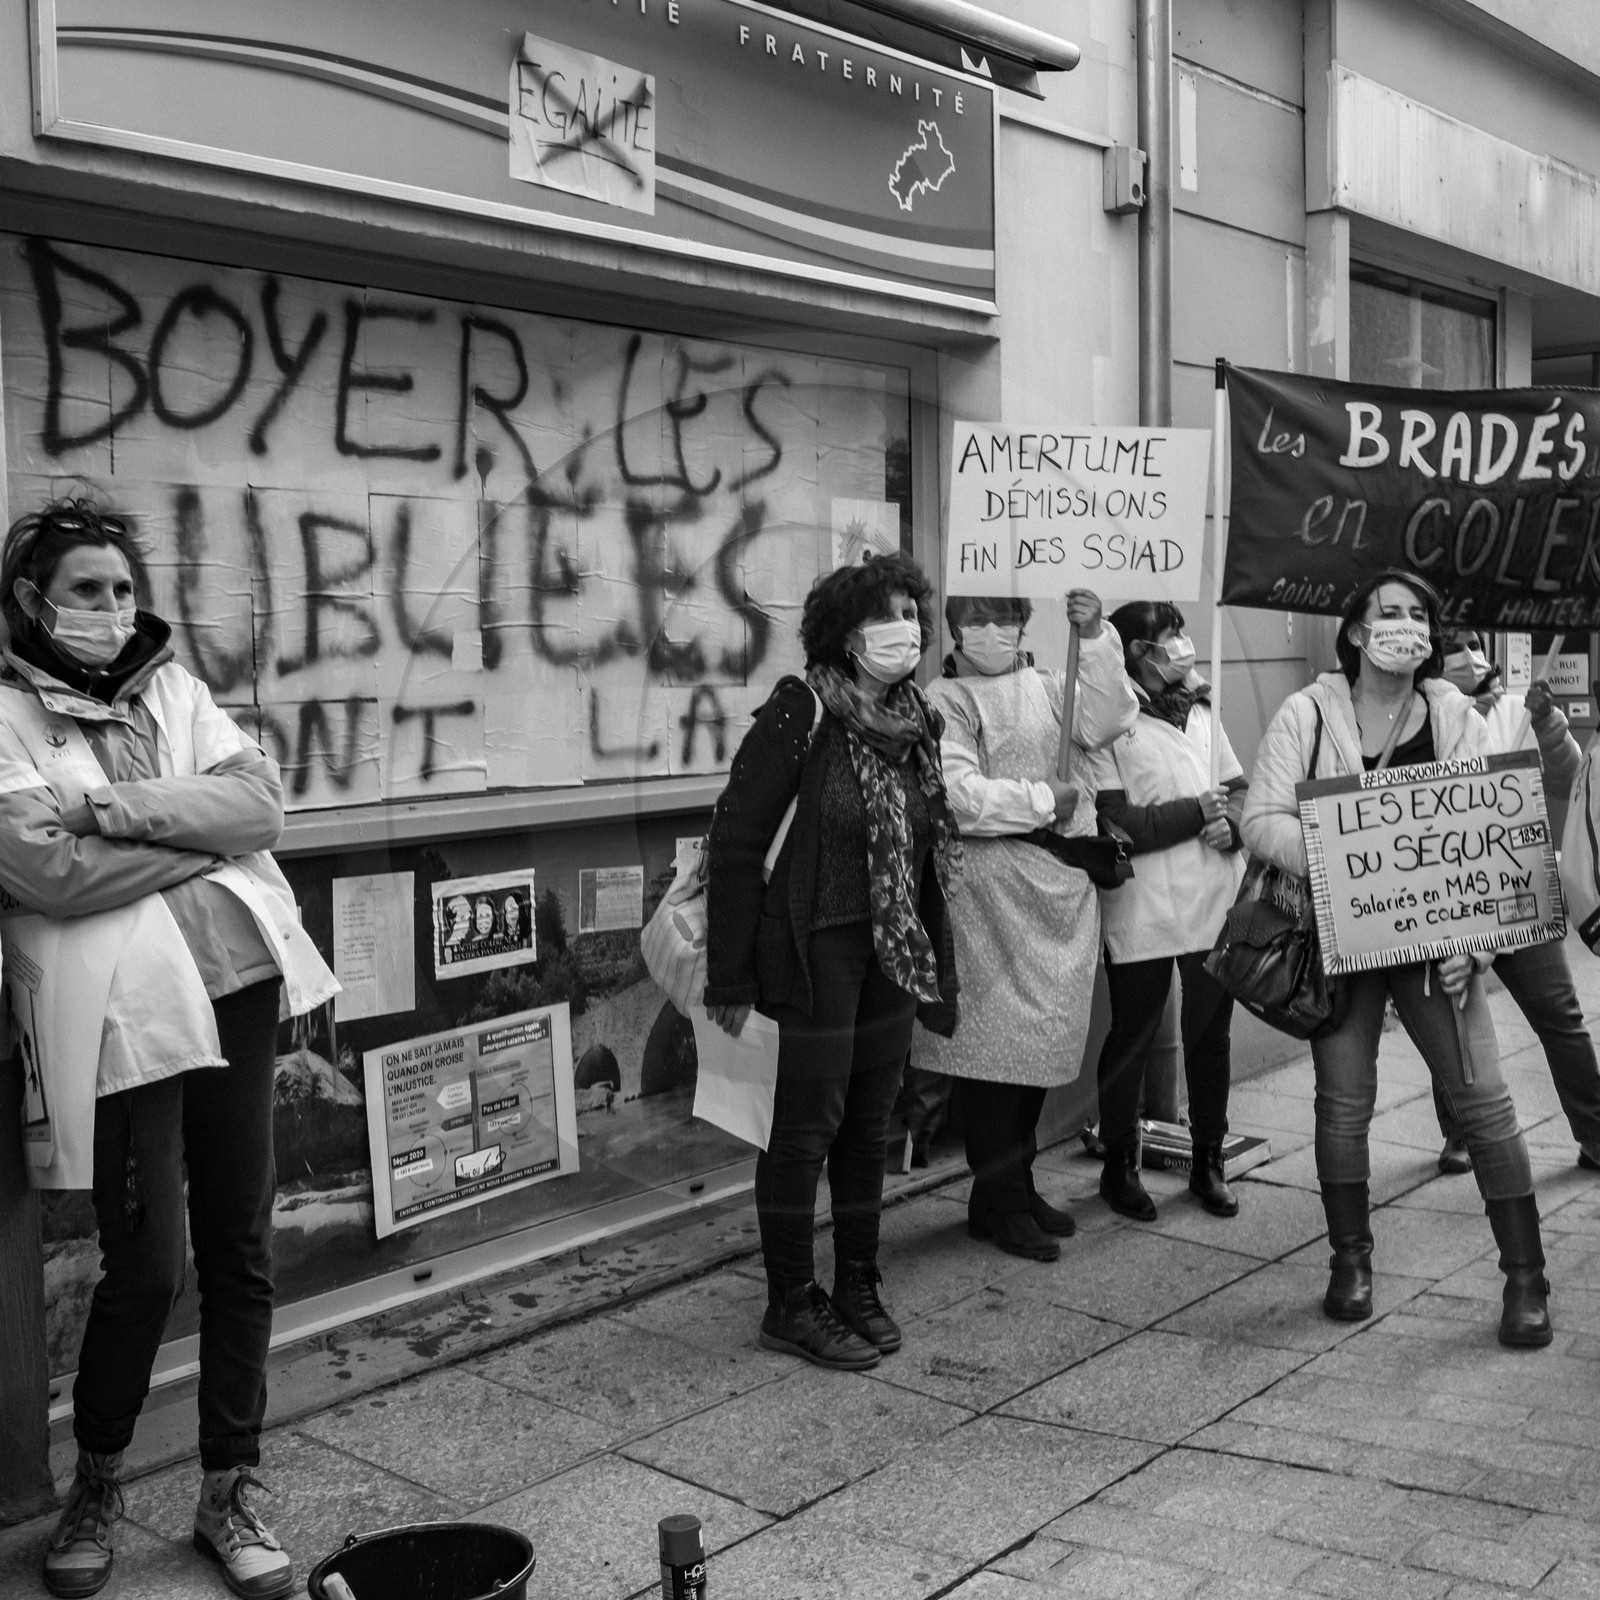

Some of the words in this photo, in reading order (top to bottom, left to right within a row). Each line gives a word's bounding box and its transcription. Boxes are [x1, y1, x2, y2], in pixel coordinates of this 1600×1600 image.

[739, 24, 964, 115] FRATERNITÉ
[27, 237, 537, 481] BOYER
[615, 334, 792, 496] LES
[958, 433, 1167, 477] AMERTUME
[1339, 397, 1586, 485] BRADÉS
[981, 479, 1167, 521] DÉMISSIONS
[1296, 495, 1368, 549] en
[1015, 537, 1066, 569] DES
[1560, 660, 1578, 670] RUE
[589, 686, 725, 766] LA
[1337, 792, 1402, 835] LES
[1411, 774, 1523, 821] EXCLUS
[1346, 851, 1382, 878] DU
[1394, 823, 1523, 871] SÉGUR
[1350, 887, 1418, 918] Salariés
[1422, 888, 1440, 904] en
[1446, 870, 1490, 898] MAS
[1394, 917, 1418, 933] en
[1426, 898, 1496, 925] COLÈRE
[386, 1053, 400, 1067] ON
[401, 1049, 413, 1062] NE
[414, 1045, 432, 1061] SAIT
[434, 1036, 465, 1055] JAMAIS
[387, 1065, 419, 1082] QUAND
[420, 1060, 433, 1073] ON
[435, 1051, 464, 1069] CROISE
[483, 1104, 493, 1114] Pas
[410, 1149, 424, 1161] 2020
